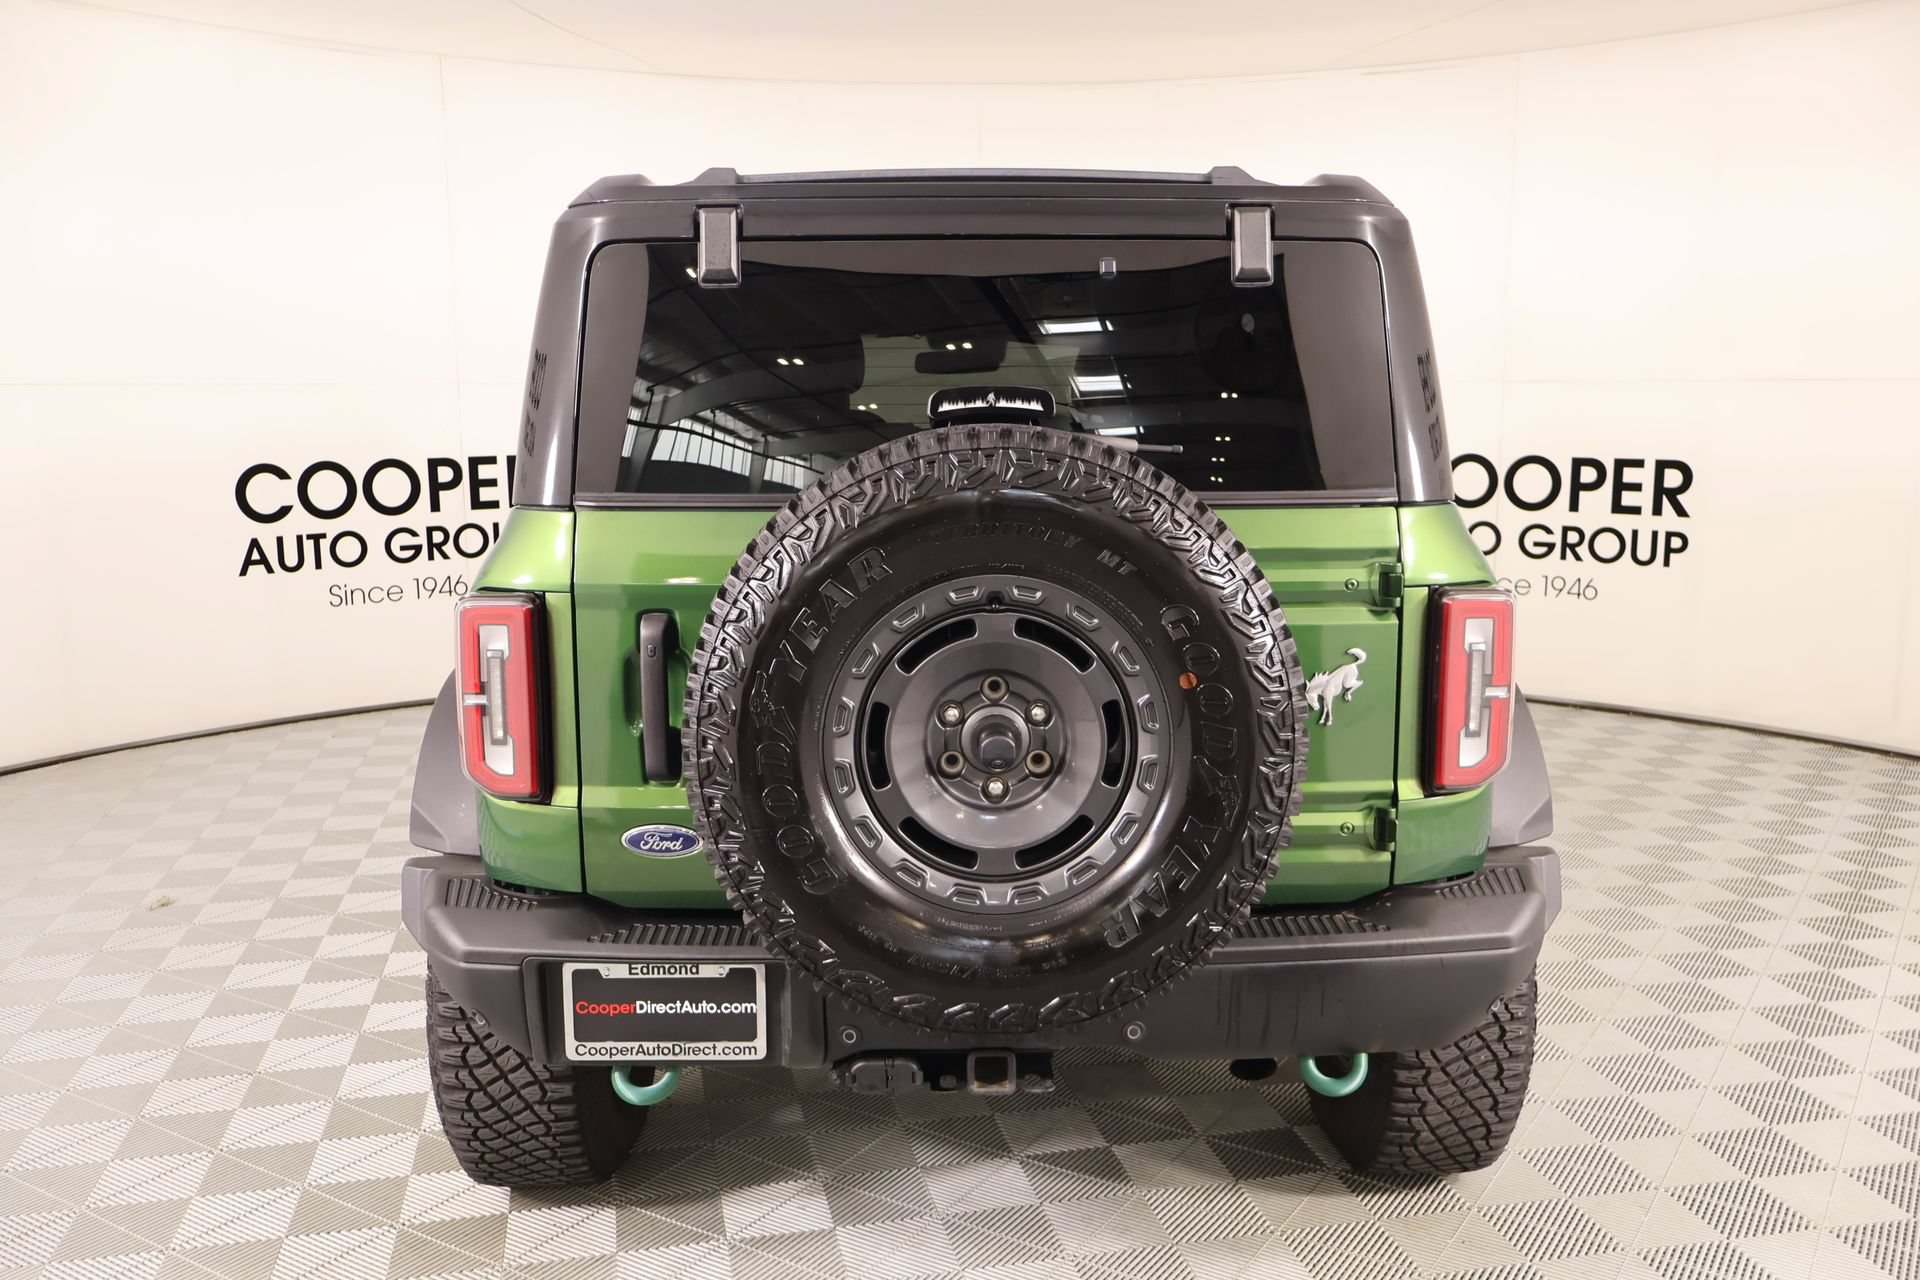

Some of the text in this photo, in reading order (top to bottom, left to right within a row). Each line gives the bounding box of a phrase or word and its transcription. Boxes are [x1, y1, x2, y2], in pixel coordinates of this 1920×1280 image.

[234, 455, 516, 524] COOPE
[1450, 453, 1694, 518] OOPER
[238, 522, 499, 577] AUTO GRO
[1518, 523, 1689, 568] GROUP
[1097, 549, 1138, 576] MT
[328, 574, 469, 608] Since 1946
[1541, 574, 1598, 601] 1946
[640, 831, 684, 850] Ford
[628, 963, 700, 976] Edmond
[575, 1000, 757, 1017] CooperDirectAuto.com
[575, 1043, 758, 1059] CooperAutoDirect.com
